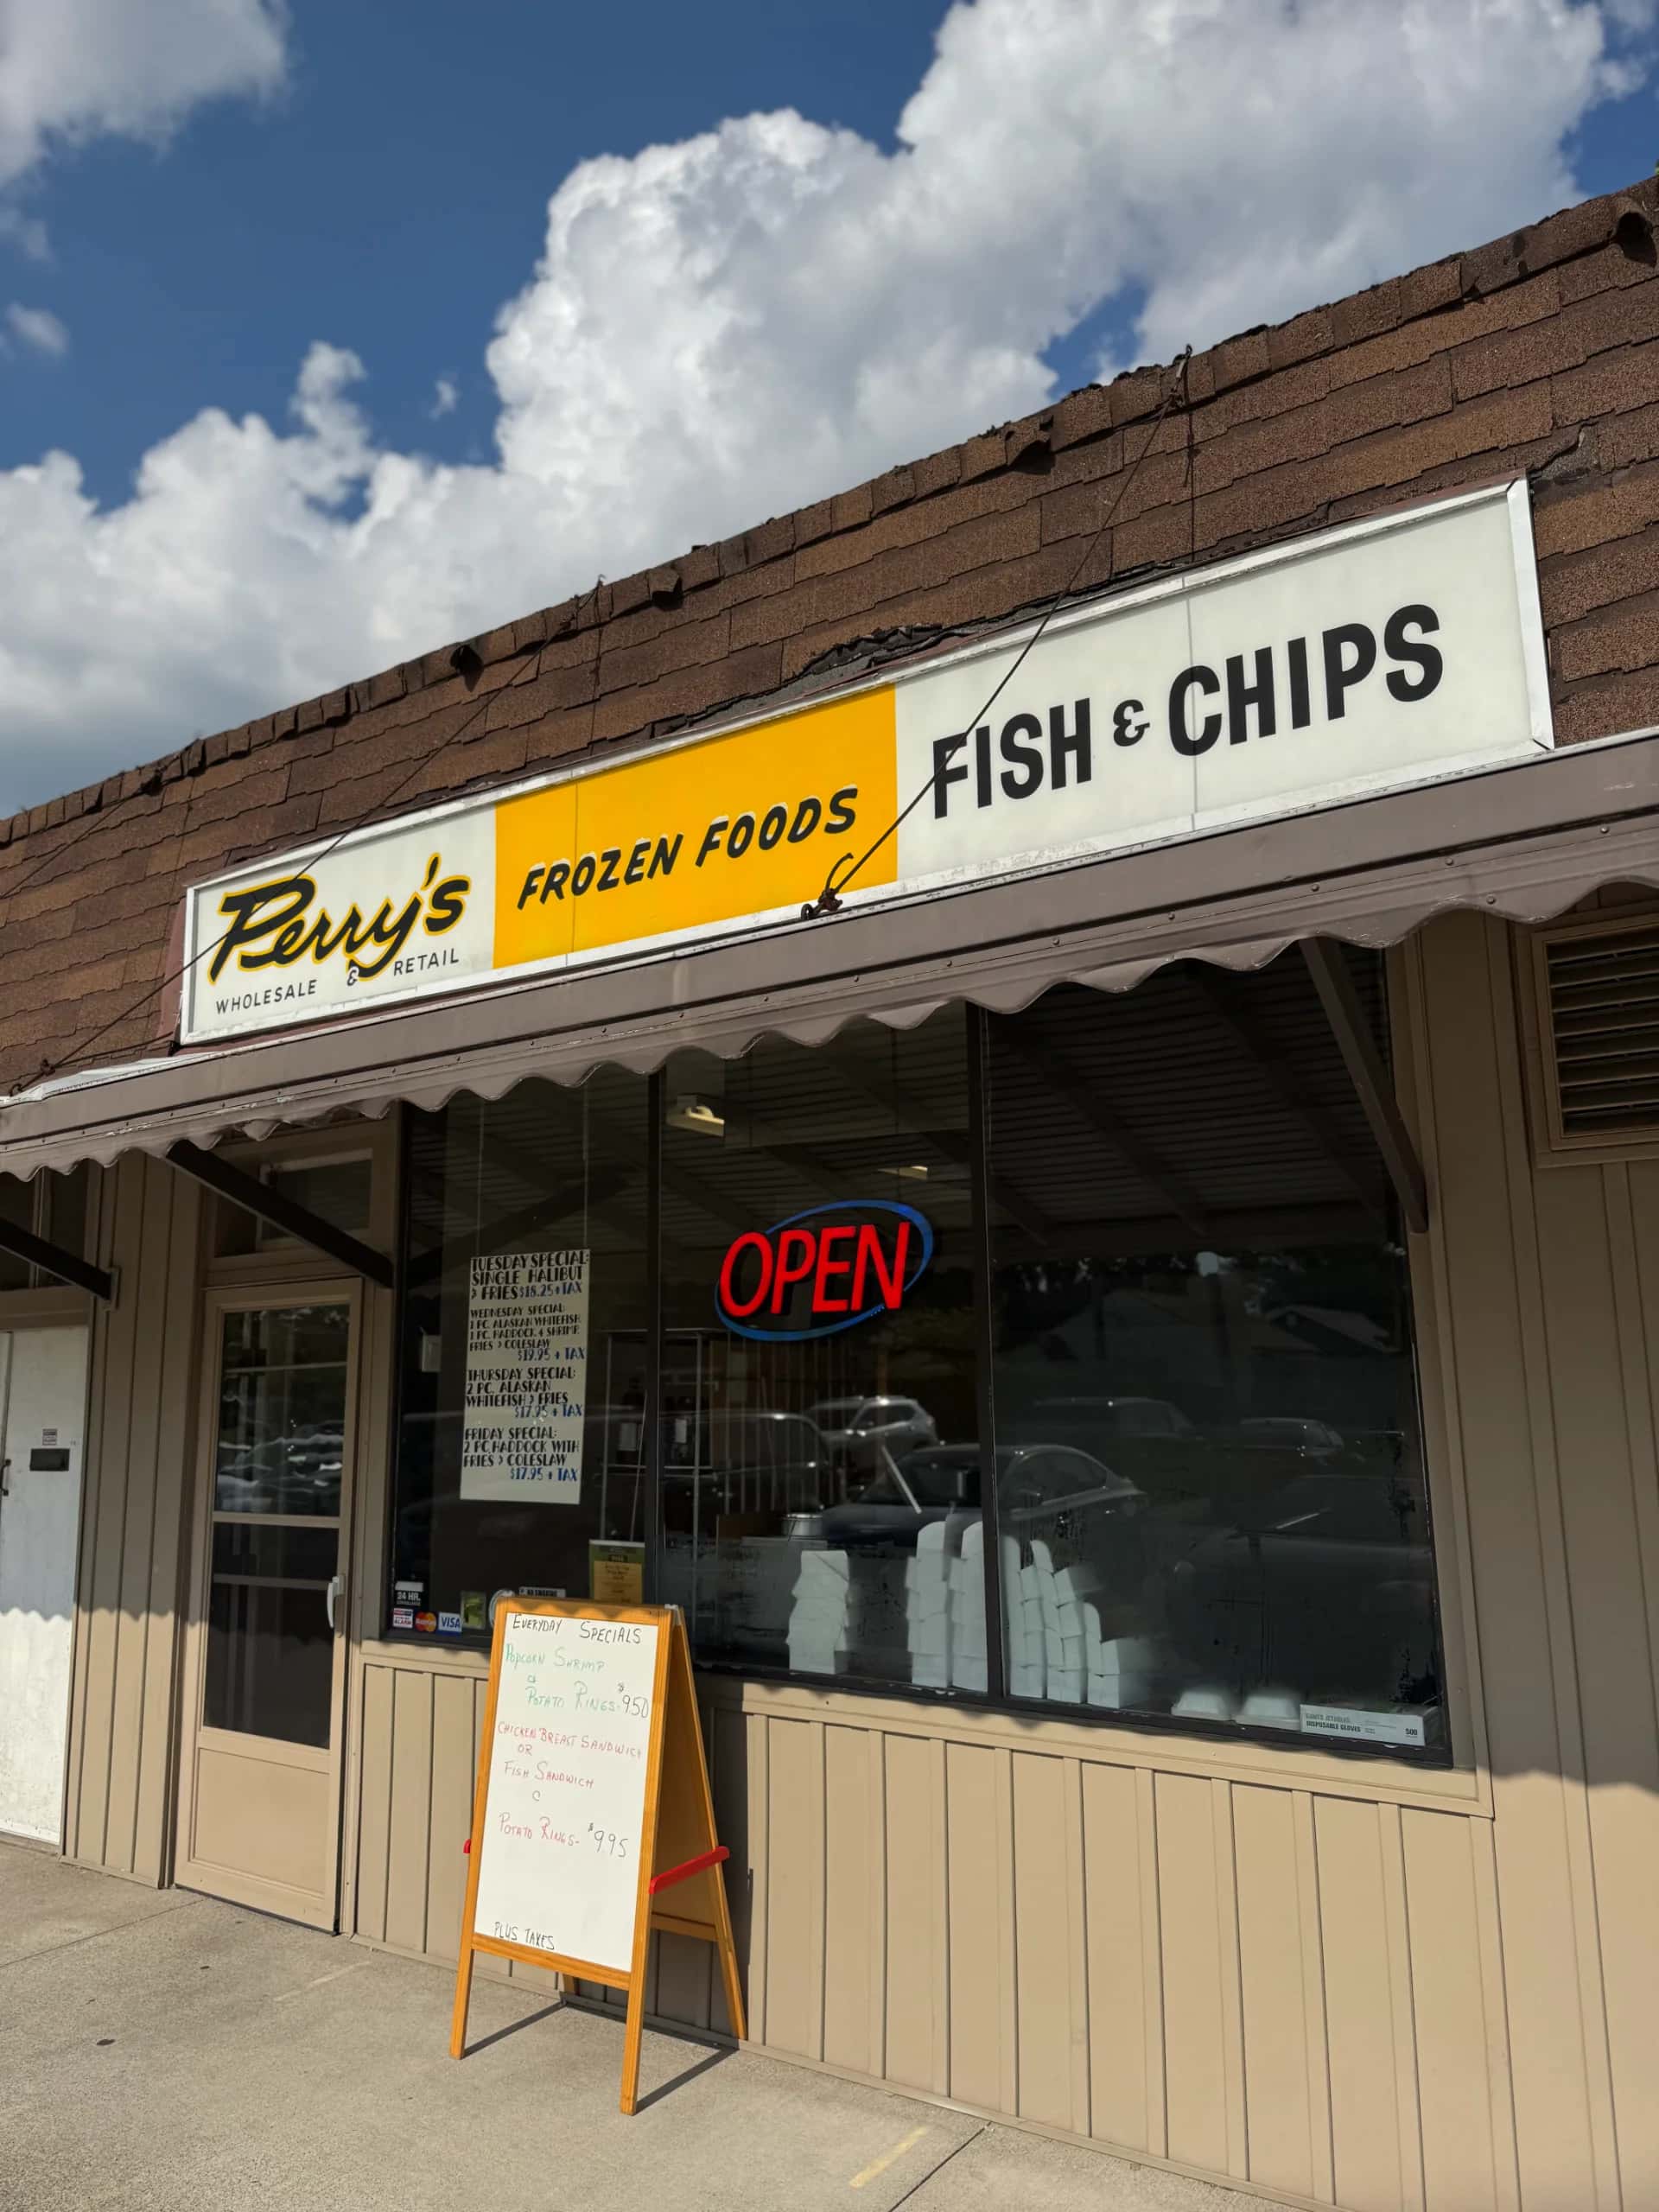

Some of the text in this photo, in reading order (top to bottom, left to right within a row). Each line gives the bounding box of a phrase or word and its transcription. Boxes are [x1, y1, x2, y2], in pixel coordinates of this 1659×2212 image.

[932, 604, 1443, 820] FISH & CHIPS
[518, 785, 858, 911] FROZEN FOODS
[207, 852, 472, 986] Perry's
[216, 948, 459, 1014] WHOLESALE & RETAIL
[471, 1255, 527, 1272] TUESDAY
[719, 1222, 911, 1317] OPEN
[472, 1266, 582, 1286] SINGLE HALIBUT
[481, 1286, 518, 1300] FRIES
[470, 1307, 524, 1318] WEDNESDAY
[493, 1317, 532, 1328] ALASKAN
[469, 1340, 493, 1351] FRIES
[504, 1338, 550, 1350] COLESLAW
[564, 1347, 586, 1360] TAX
[468, 1368, 523, 1382] THURSDAY
[499, 1380, 551, 1393] ALASKAN
[467, 1394, 525, 1408] WHITEFISH
[538, 1392, 569, 1404] FRIES
[563, 1404, 582, 1417] TAX
[465, 1427, 504, 1440] FRIDAY
[493, 1440, 547, 1453] HADDOCK
[551, 1440, 580, 1452] WITH
[463, 1454, 494, 1467] FRIES
[506, 1453, 567, 1467] COLESLAW
[557, 1468, 578, 1481] TAX
[442, 1617, 461, 1628] VISA
[512, 1613, 642, 1644] EVERYDAY SPECIALS
[518, 1744, 533, 1757] OR
[534, 1760, 594, 1789] SANDWICH
[494, 1921, 555, 1950] PLUS TAXES
